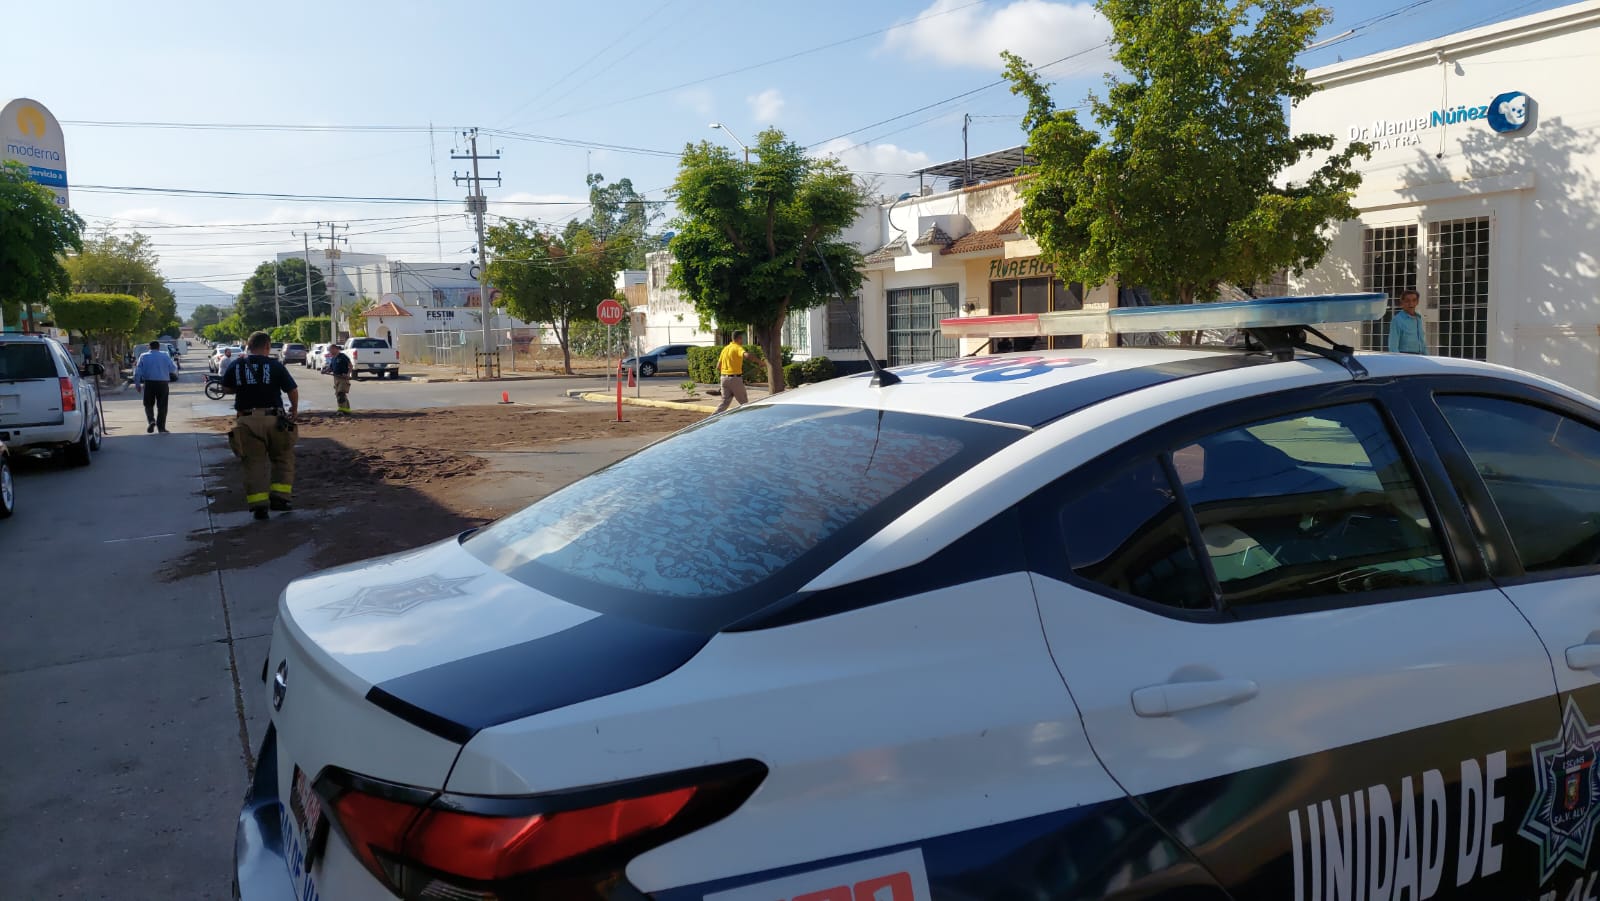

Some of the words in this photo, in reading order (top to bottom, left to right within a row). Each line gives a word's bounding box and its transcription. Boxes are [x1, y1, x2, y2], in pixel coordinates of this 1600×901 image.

[1350, 126, 1369, 141] Dr.
[7, 144, 60, 160] moderna
[426, 310, 455, 318] FESTIN
[601, 306, 620, 319] ALTO
[1288, 768, 1447, 901] UNIDAD
[1456, 750, 1507, 887] DE
